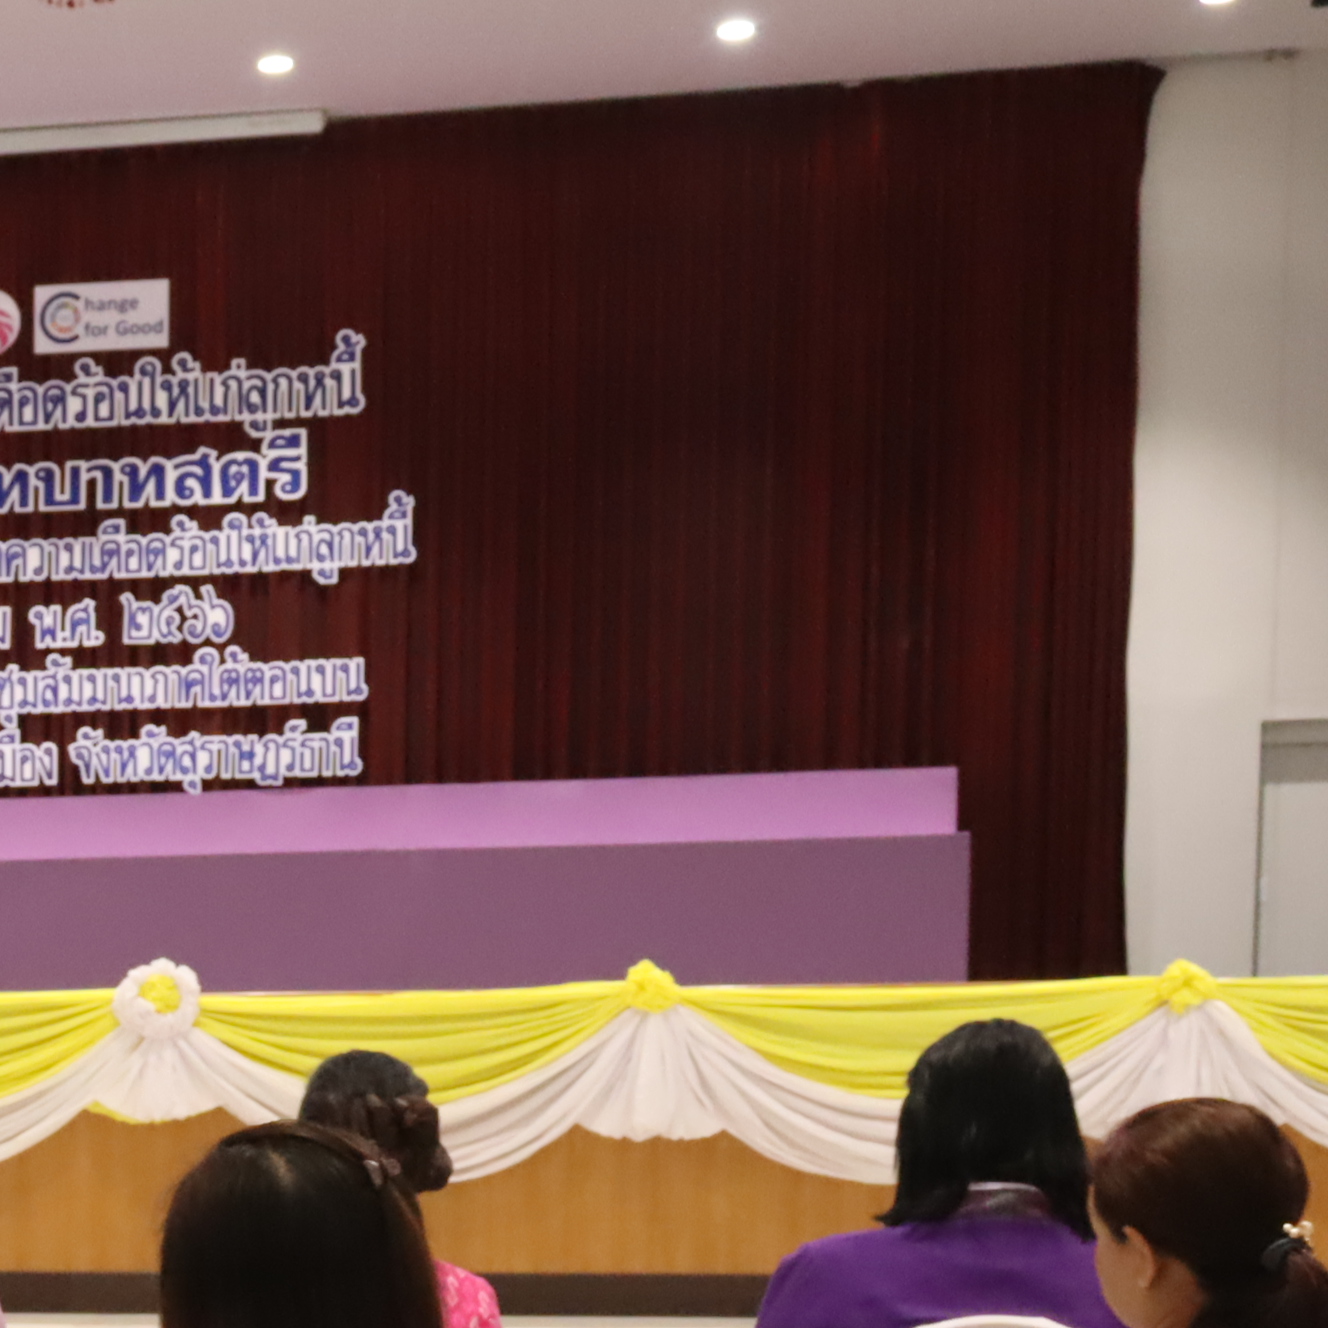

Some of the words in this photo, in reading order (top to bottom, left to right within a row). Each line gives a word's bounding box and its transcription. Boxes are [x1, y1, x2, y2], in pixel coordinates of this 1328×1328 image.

[85, 321, 109, 337] for
[115, 318, 165, 339] Good
[28, 598, 105, 649] พ.ศ.
[120, 585, 236, 645] ๒๕๖๖
[68, 716, 364, 794] จังหวัดสุราษฎร์ธานี
